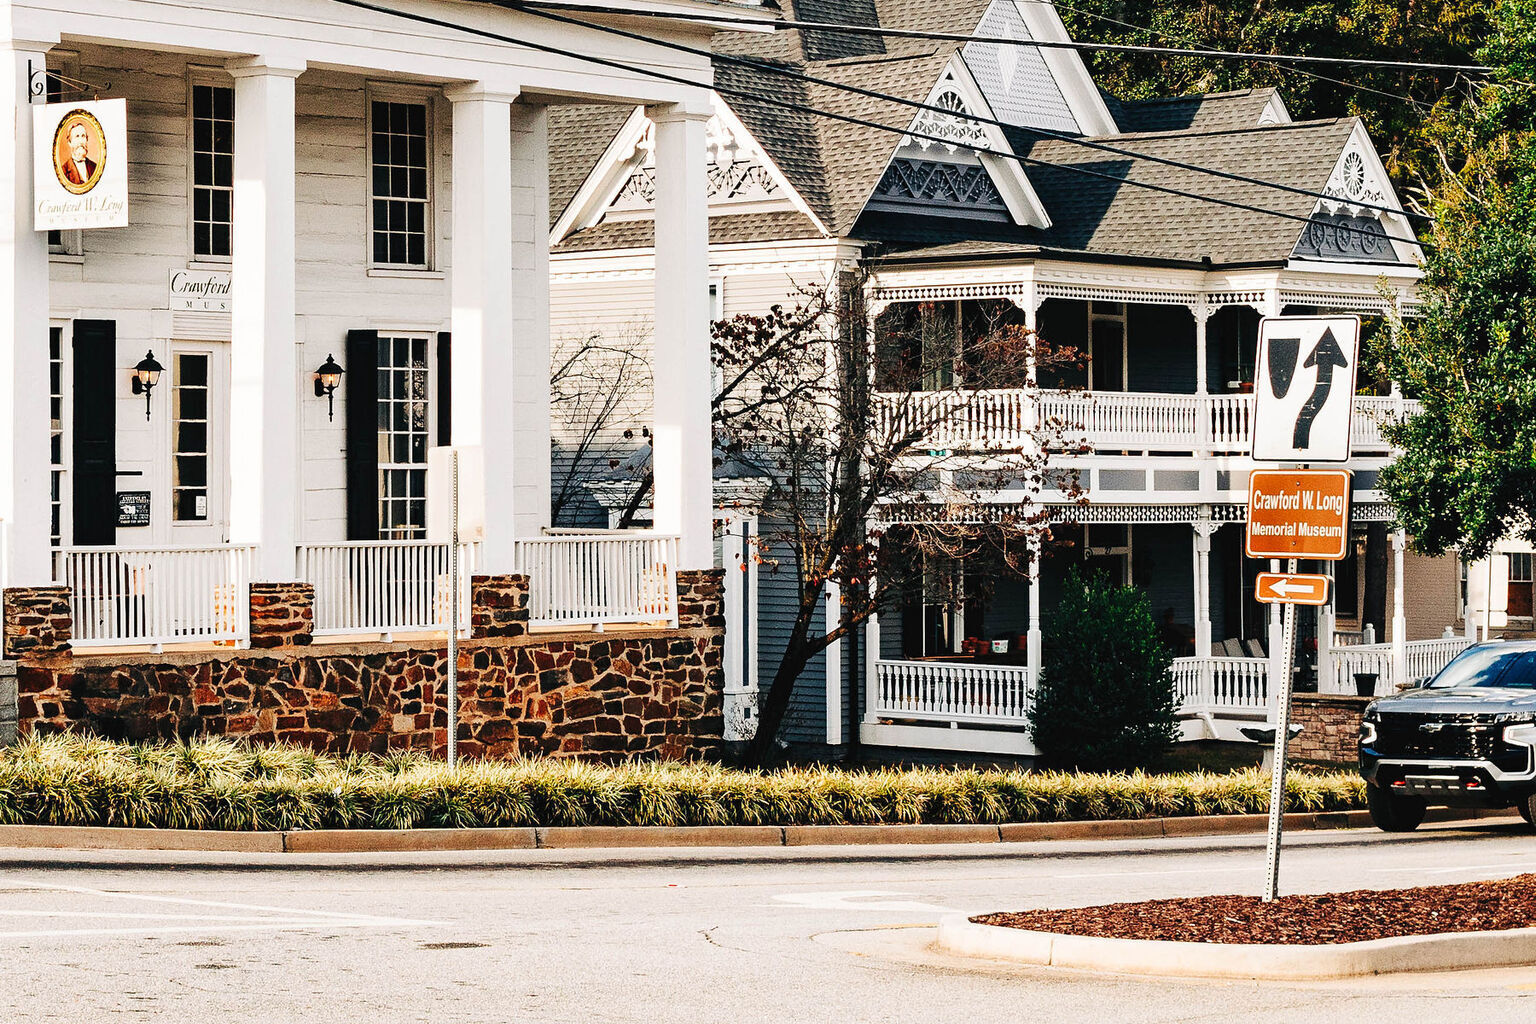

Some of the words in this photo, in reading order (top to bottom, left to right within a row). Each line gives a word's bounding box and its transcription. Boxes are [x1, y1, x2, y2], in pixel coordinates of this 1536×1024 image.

[38, 198, 82, 215] Crawford
[99, 196, 124, 214] Long
[171, 271, 232, 297] Crawford
[1253, 489, 1300, 510] Crawford
[1302, 490, 1314, 510] W.
[1316, 490, 1343, 516] Long
[1251, 521, 1297, 537] Memorial
[1298, 522, 1342, 537] Museum
